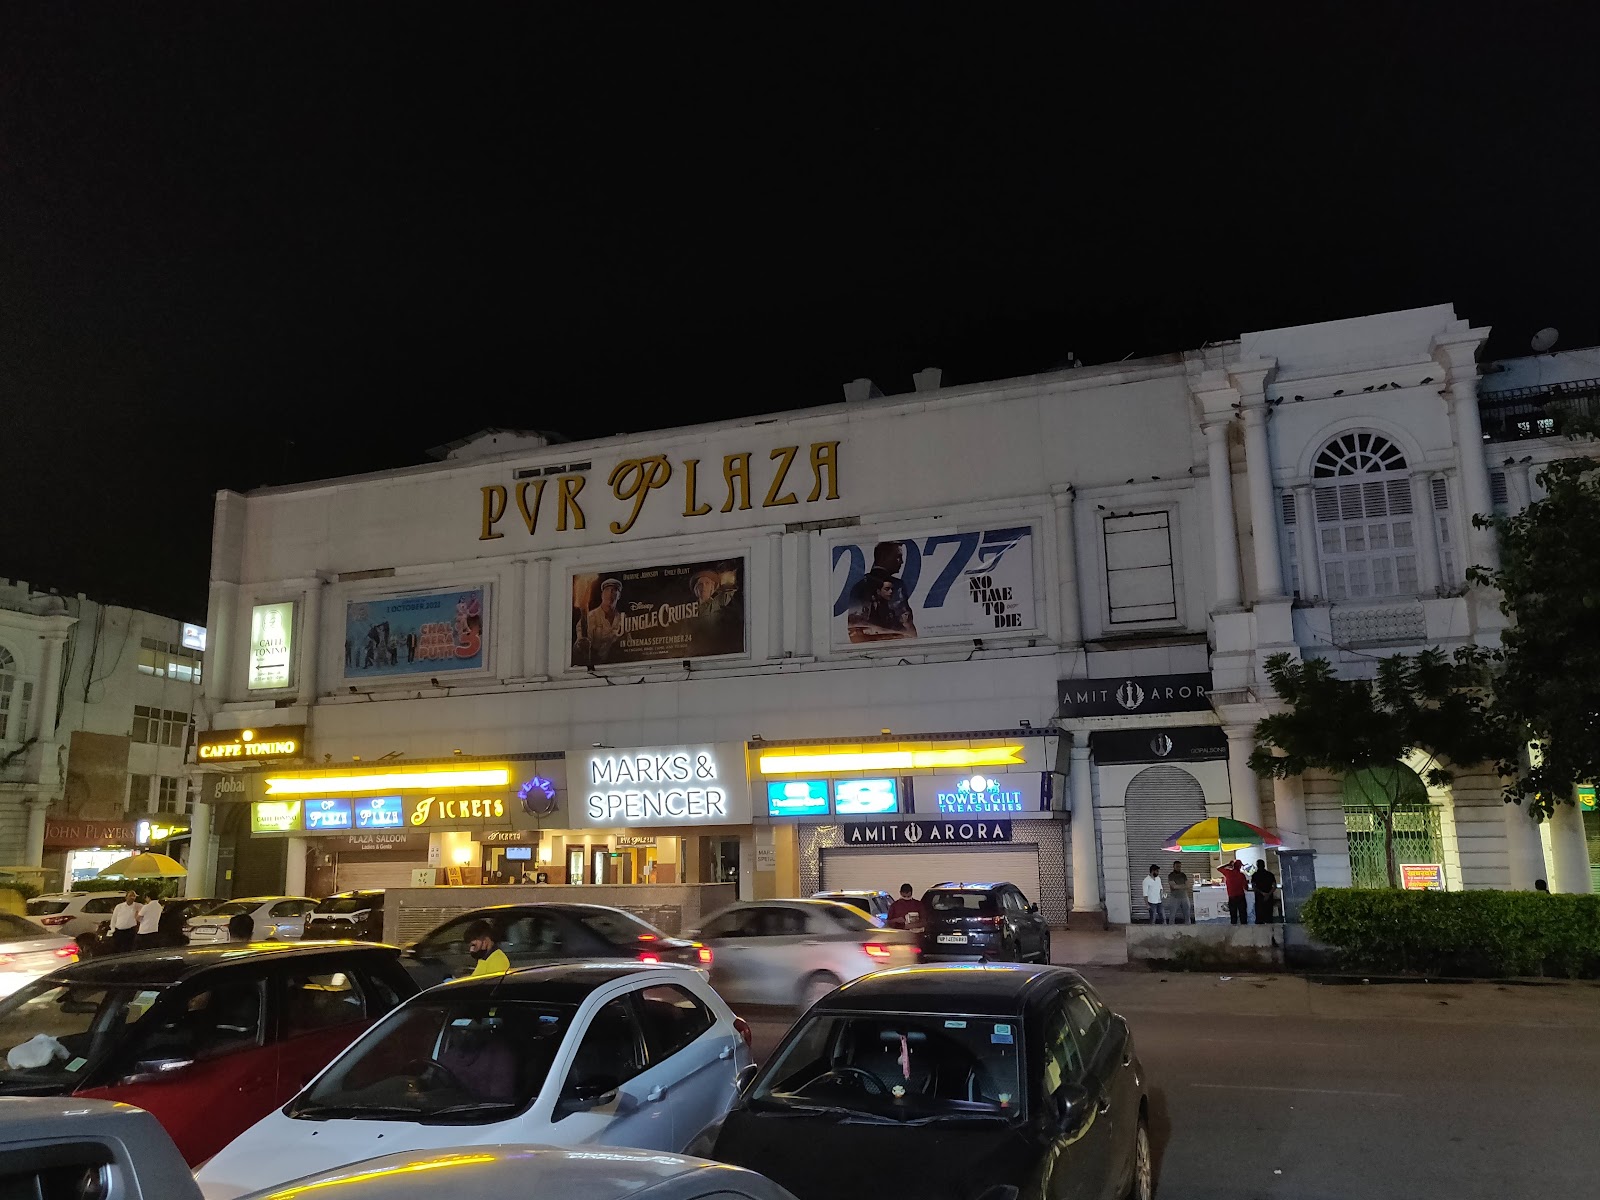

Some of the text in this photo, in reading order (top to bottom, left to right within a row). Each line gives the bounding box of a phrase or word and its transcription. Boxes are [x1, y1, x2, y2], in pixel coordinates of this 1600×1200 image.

[479, 440, 841, 541] PVR PLAZA
[969, 575, 992, 590] NO
[969, 587, 1013, 603] TIME
[391, 603, 424, 613] OCTOBER
[982, 601, 1005, 615] TO
[616, 601, 700, 637] JUNGLE CRUISE
[994, 613, 1022, 628] DIE
[627, 637, 652, 647] CINEMAS
[652, 635, 685, 645] SEPTEMBER
[685, 634, 692, 642] 24
[1063, 685, 1206, 704] AMIT AROR
[244, 741, 295, 755] TONINO
[591, 754, 715, 784] MARKS &
[214, 776, 245, 798] global
[320, 801, 335, 810] CP
[371, 799, 385, 809] CP
[588, 790, 725, 819] SPENCER
[938, 792, 1021, 805] POWER GILT
[410, 796, 504, 826] TICKETS
[940, 803, 1022, 813] TREASURIES
[310, 811, 347, 827] PLAZA
[359, 809, 399, 826] PLAZA
[46, 823, 80, 839] JOHN
[85, 824, 135, 839] PLAYERS
[349, 834, 374, 843] PLAZA
[376, 834, 407, 843] SALOON
[851, 823, 1004, 842] AMIT ARORA
